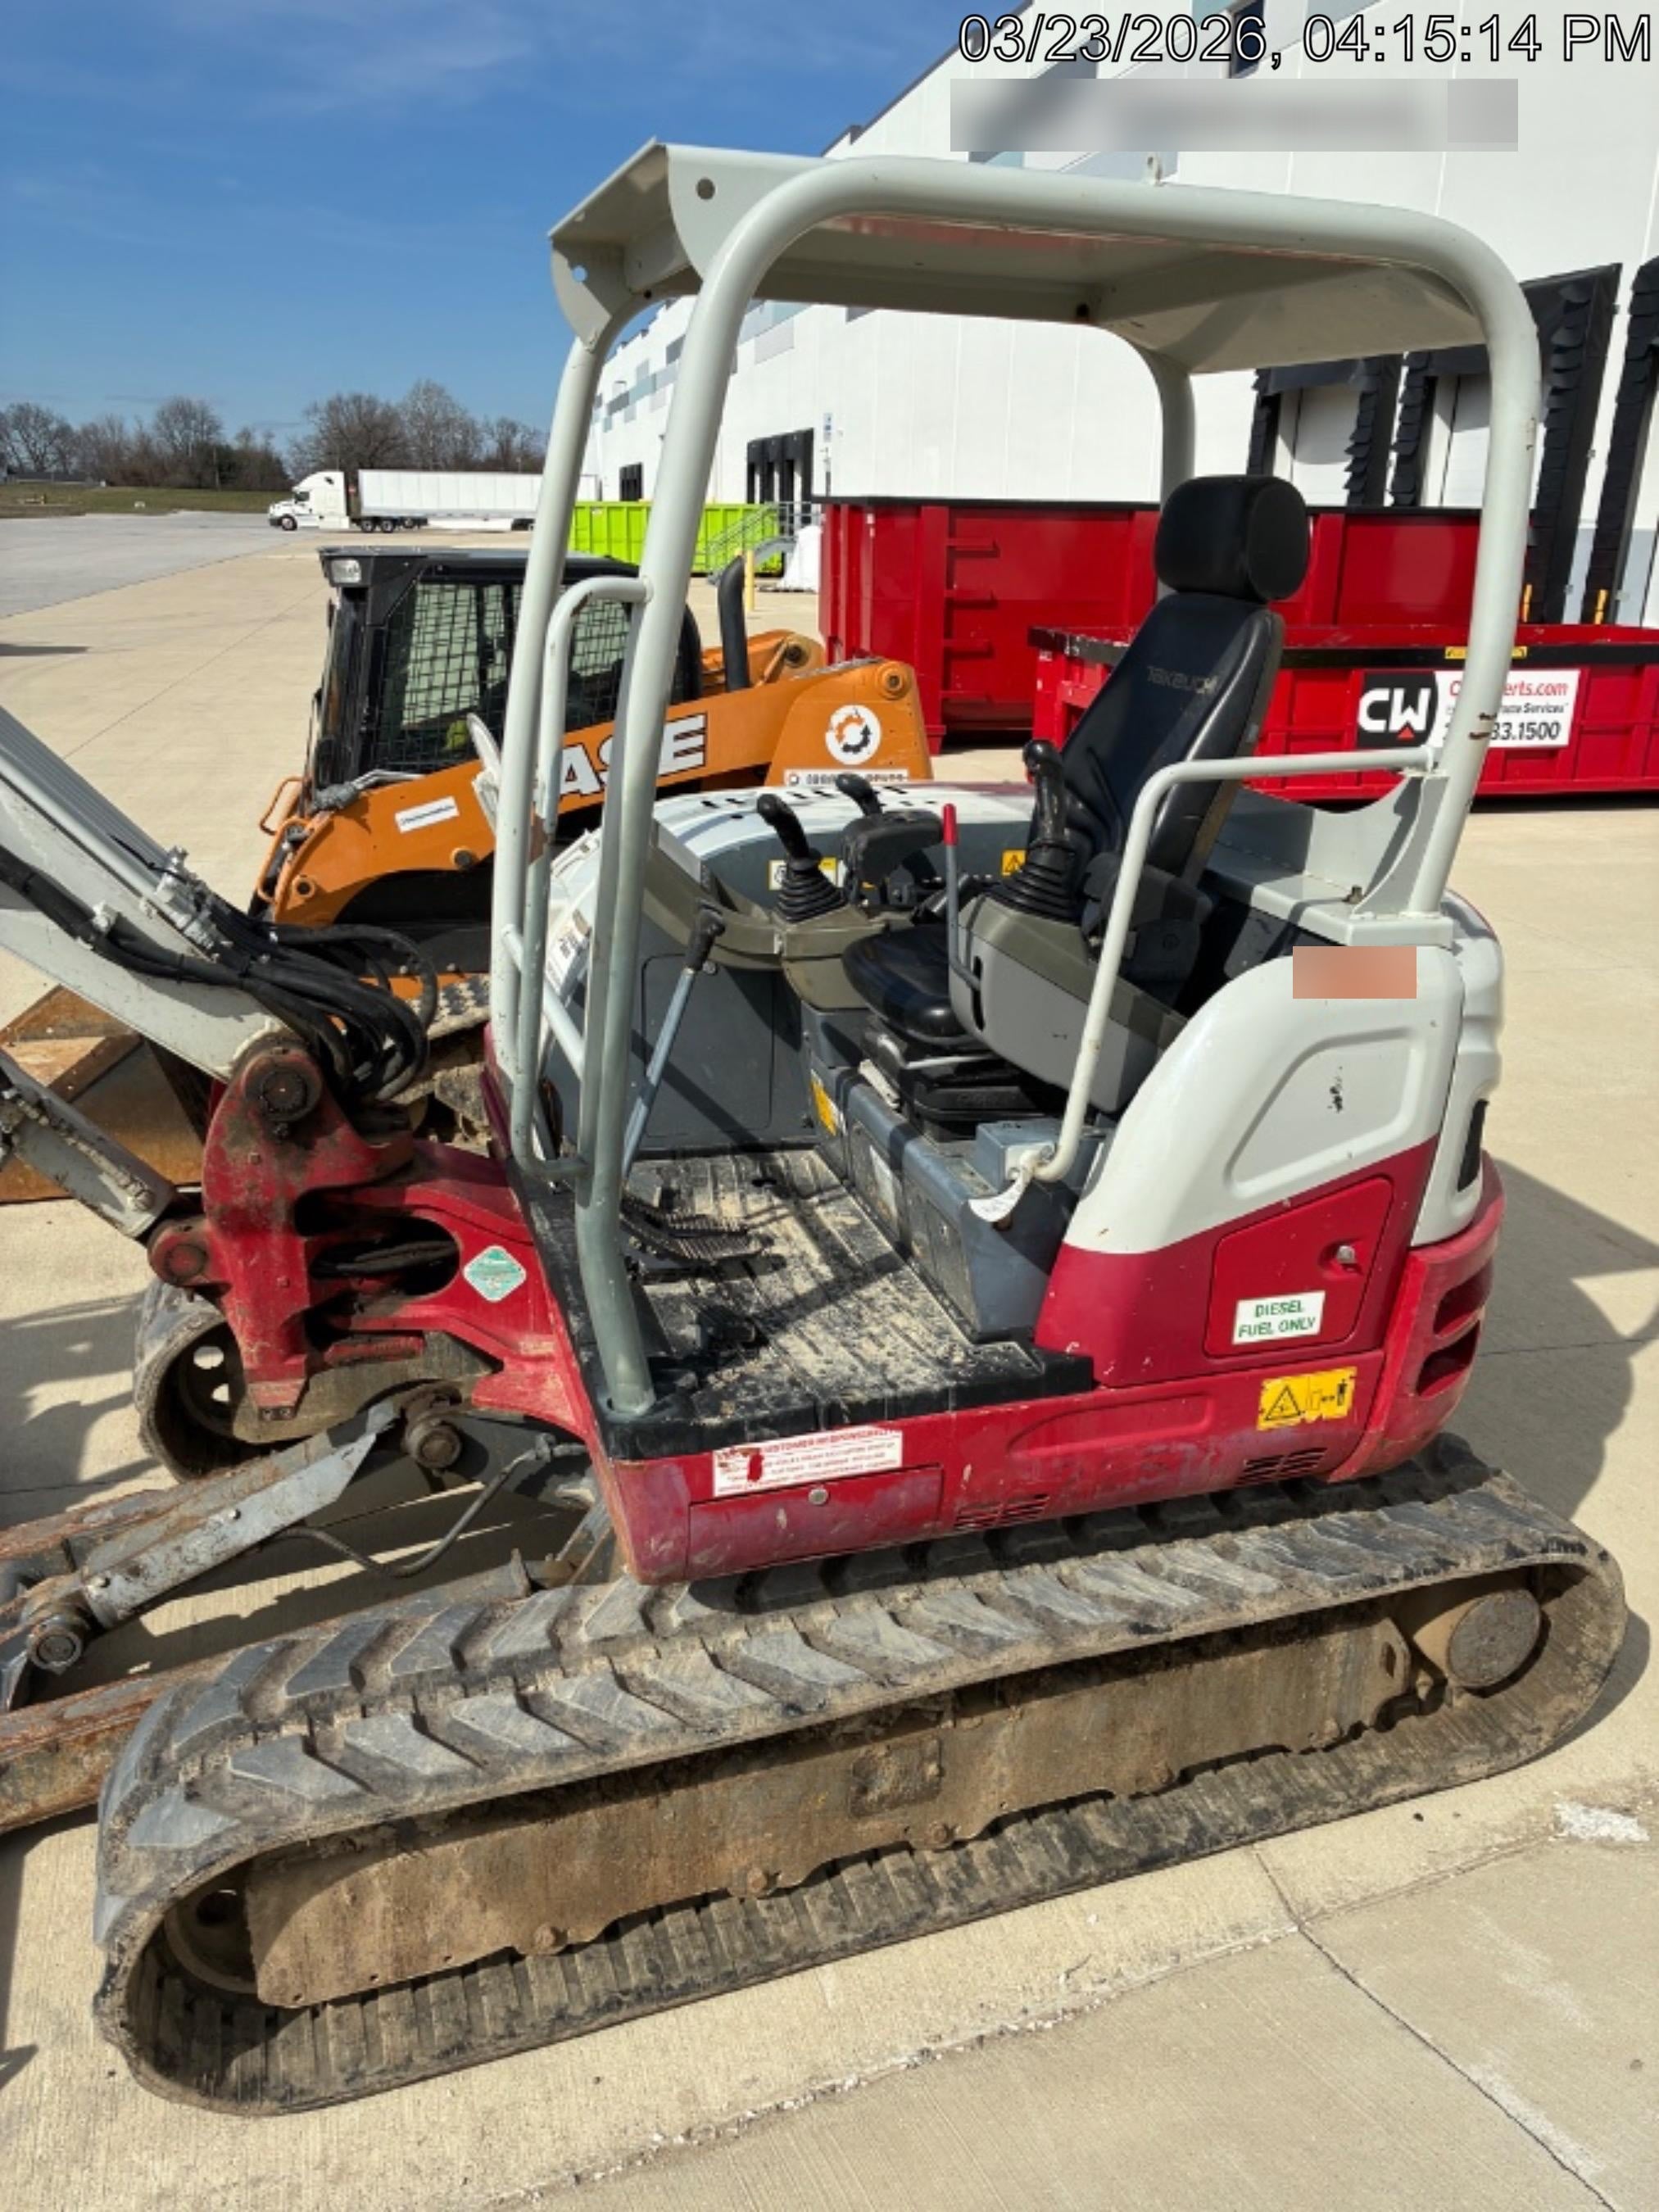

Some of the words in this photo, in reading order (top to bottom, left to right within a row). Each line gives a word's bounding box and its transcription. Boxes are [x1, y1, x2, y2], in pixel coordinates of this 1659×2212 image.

[1358, 687, 1431, 733] CW
[1254, 1300, 1303, 1318] DIESEL
[1238, 1321, 1274, 1339] FUEL
[1278, 1317, 1317, 1333] ONLY
